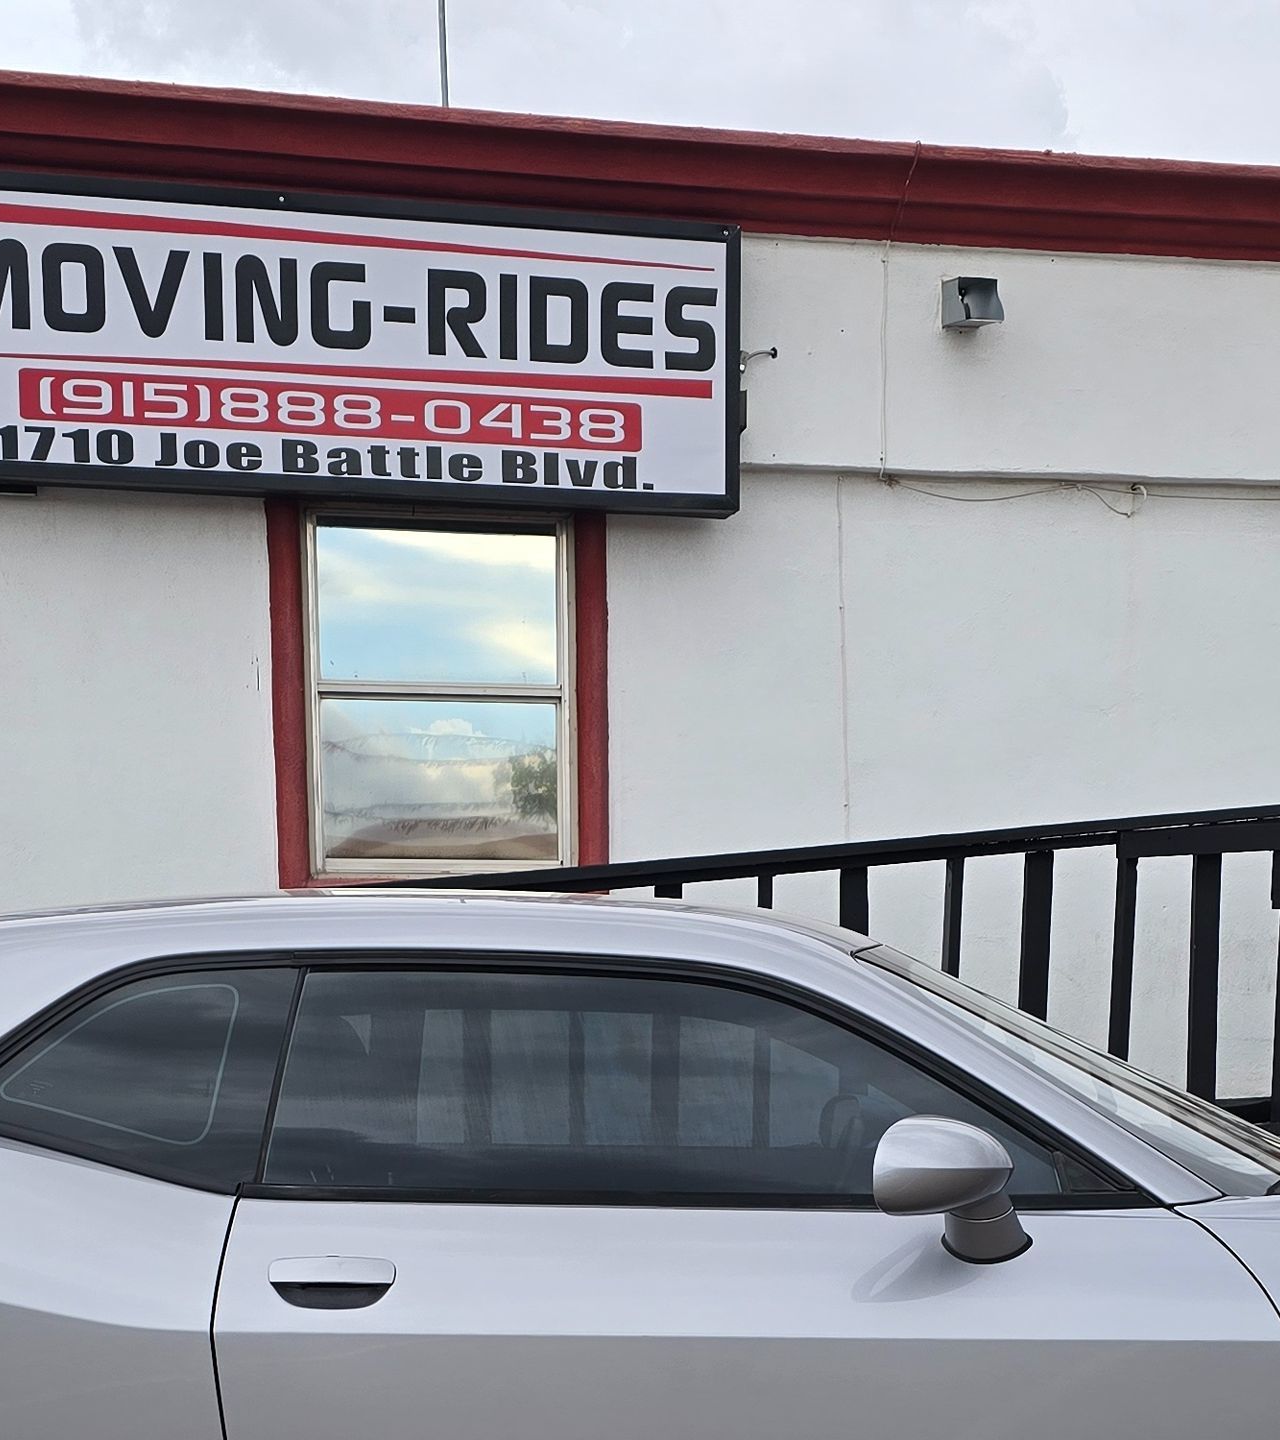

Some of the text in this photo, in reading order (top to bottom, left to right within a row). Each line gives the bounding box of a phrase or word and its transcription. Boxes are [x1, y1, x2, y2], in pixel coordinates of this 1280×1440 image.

[39, 376, 625, 444] (915)888-0438
[154, 432, 263, 471] Joe
[281, 438, 483, 483] Battle
[501, 449, 654, 491] Blvd.
